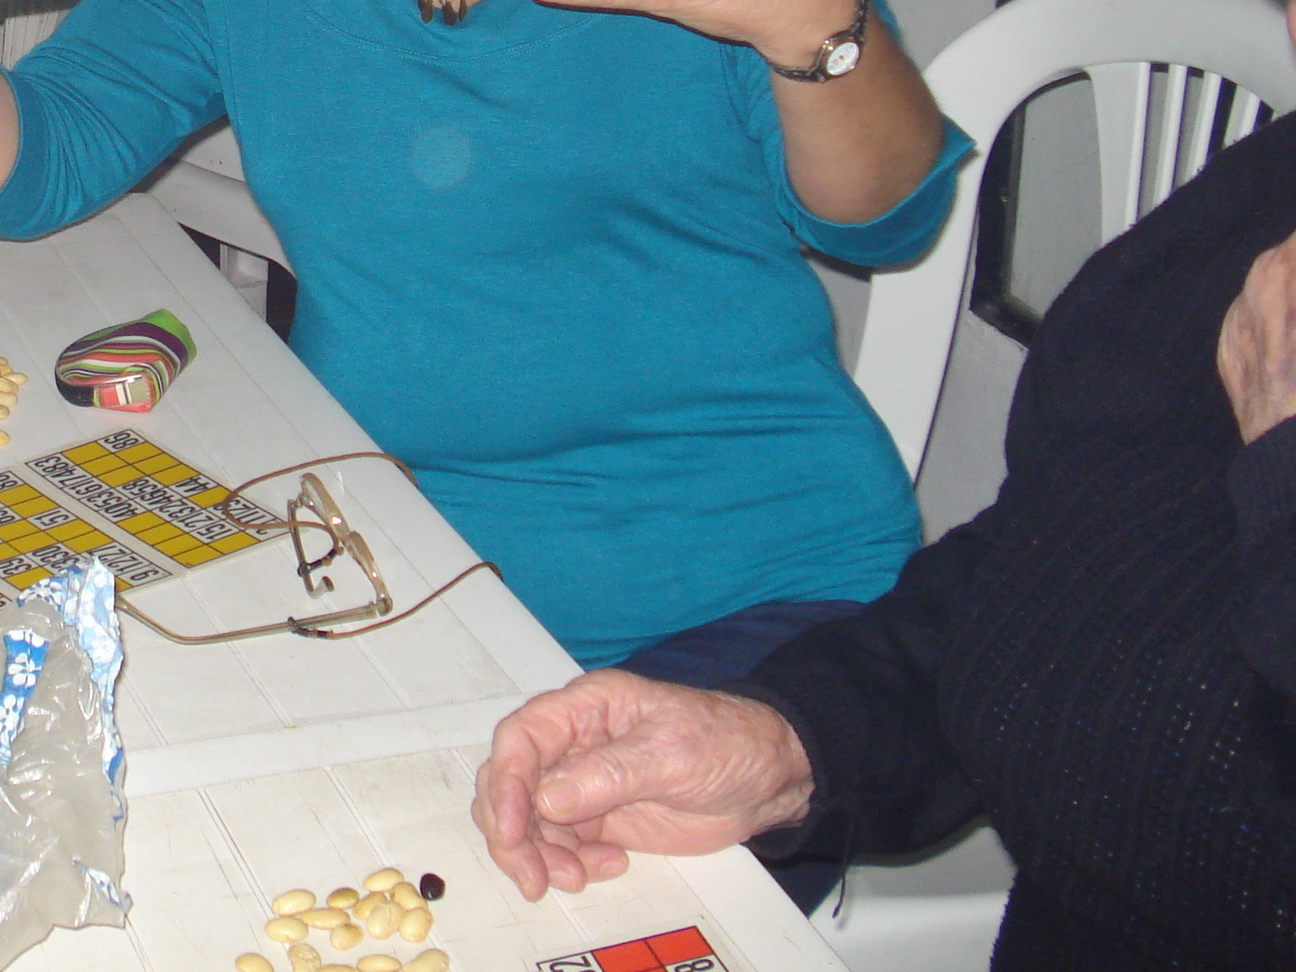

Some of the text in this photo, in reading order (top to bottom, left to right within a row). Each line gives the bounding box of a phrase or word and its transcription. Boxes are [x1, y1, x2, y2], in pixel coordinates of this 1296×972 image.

[104, 432, 138, 449] 86
[34, 456, 137, 517] 40 53 61 74 83
[175, 477, 209, 492] 44
[122, 479, 231, 539] 15 21 32 46 58
[34, 510, 69, 526] 51
[31, 545, 69, 562] 30
[85, 544, 122, 562] 27
[107, 555, 142, 572] 12
[128, 568, 157, 580] 9
